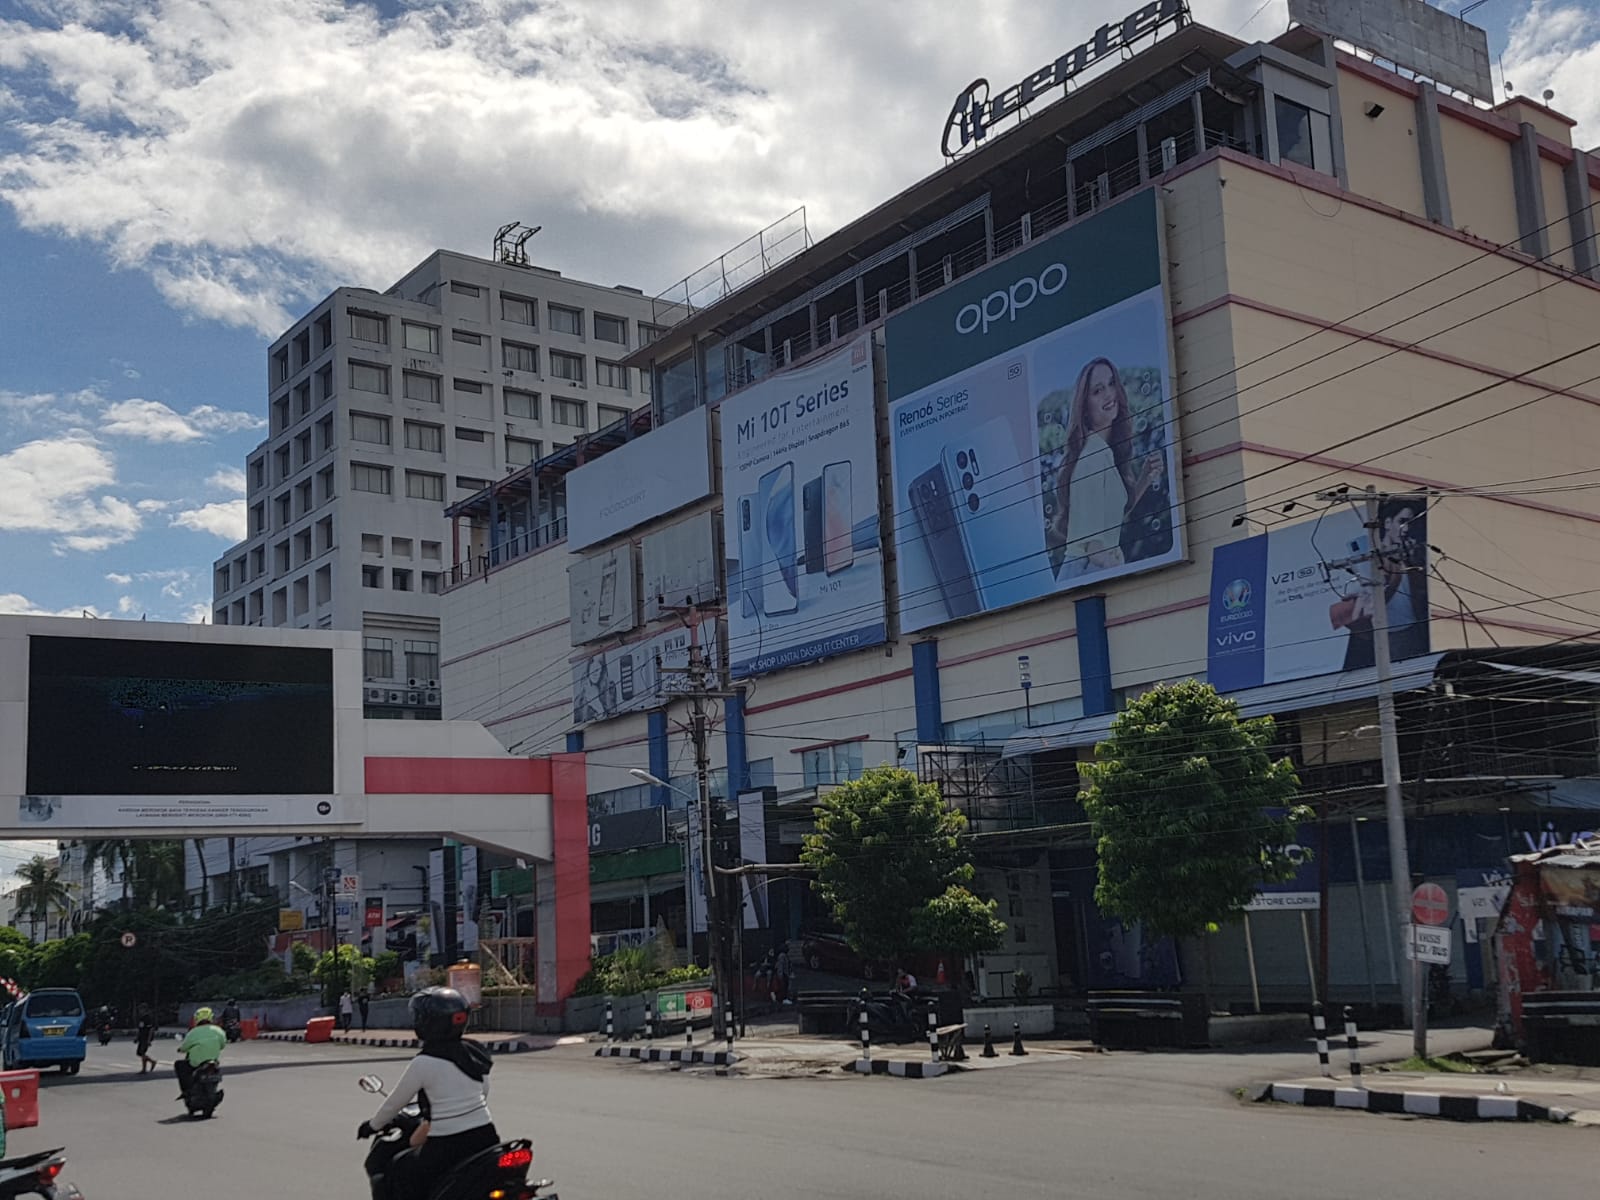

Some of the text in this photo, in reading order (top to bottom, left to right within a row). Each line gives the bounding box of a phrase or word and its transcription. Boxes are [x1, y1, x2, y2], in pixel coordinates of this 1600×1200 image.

[956, 263, 1068, 334] oppo
[737, 380, 849, 445] Mi 10T Series
[899, 389, 969, 428] Reno6 Series
[1271, 571, 1294, 585] V21
[758, 656, 776, 670] SHOP
[800, 644, 823, 658] DASAR
[831, 634, 859, 649] CENTER
[1216, 631, 1256, 646] vivo
